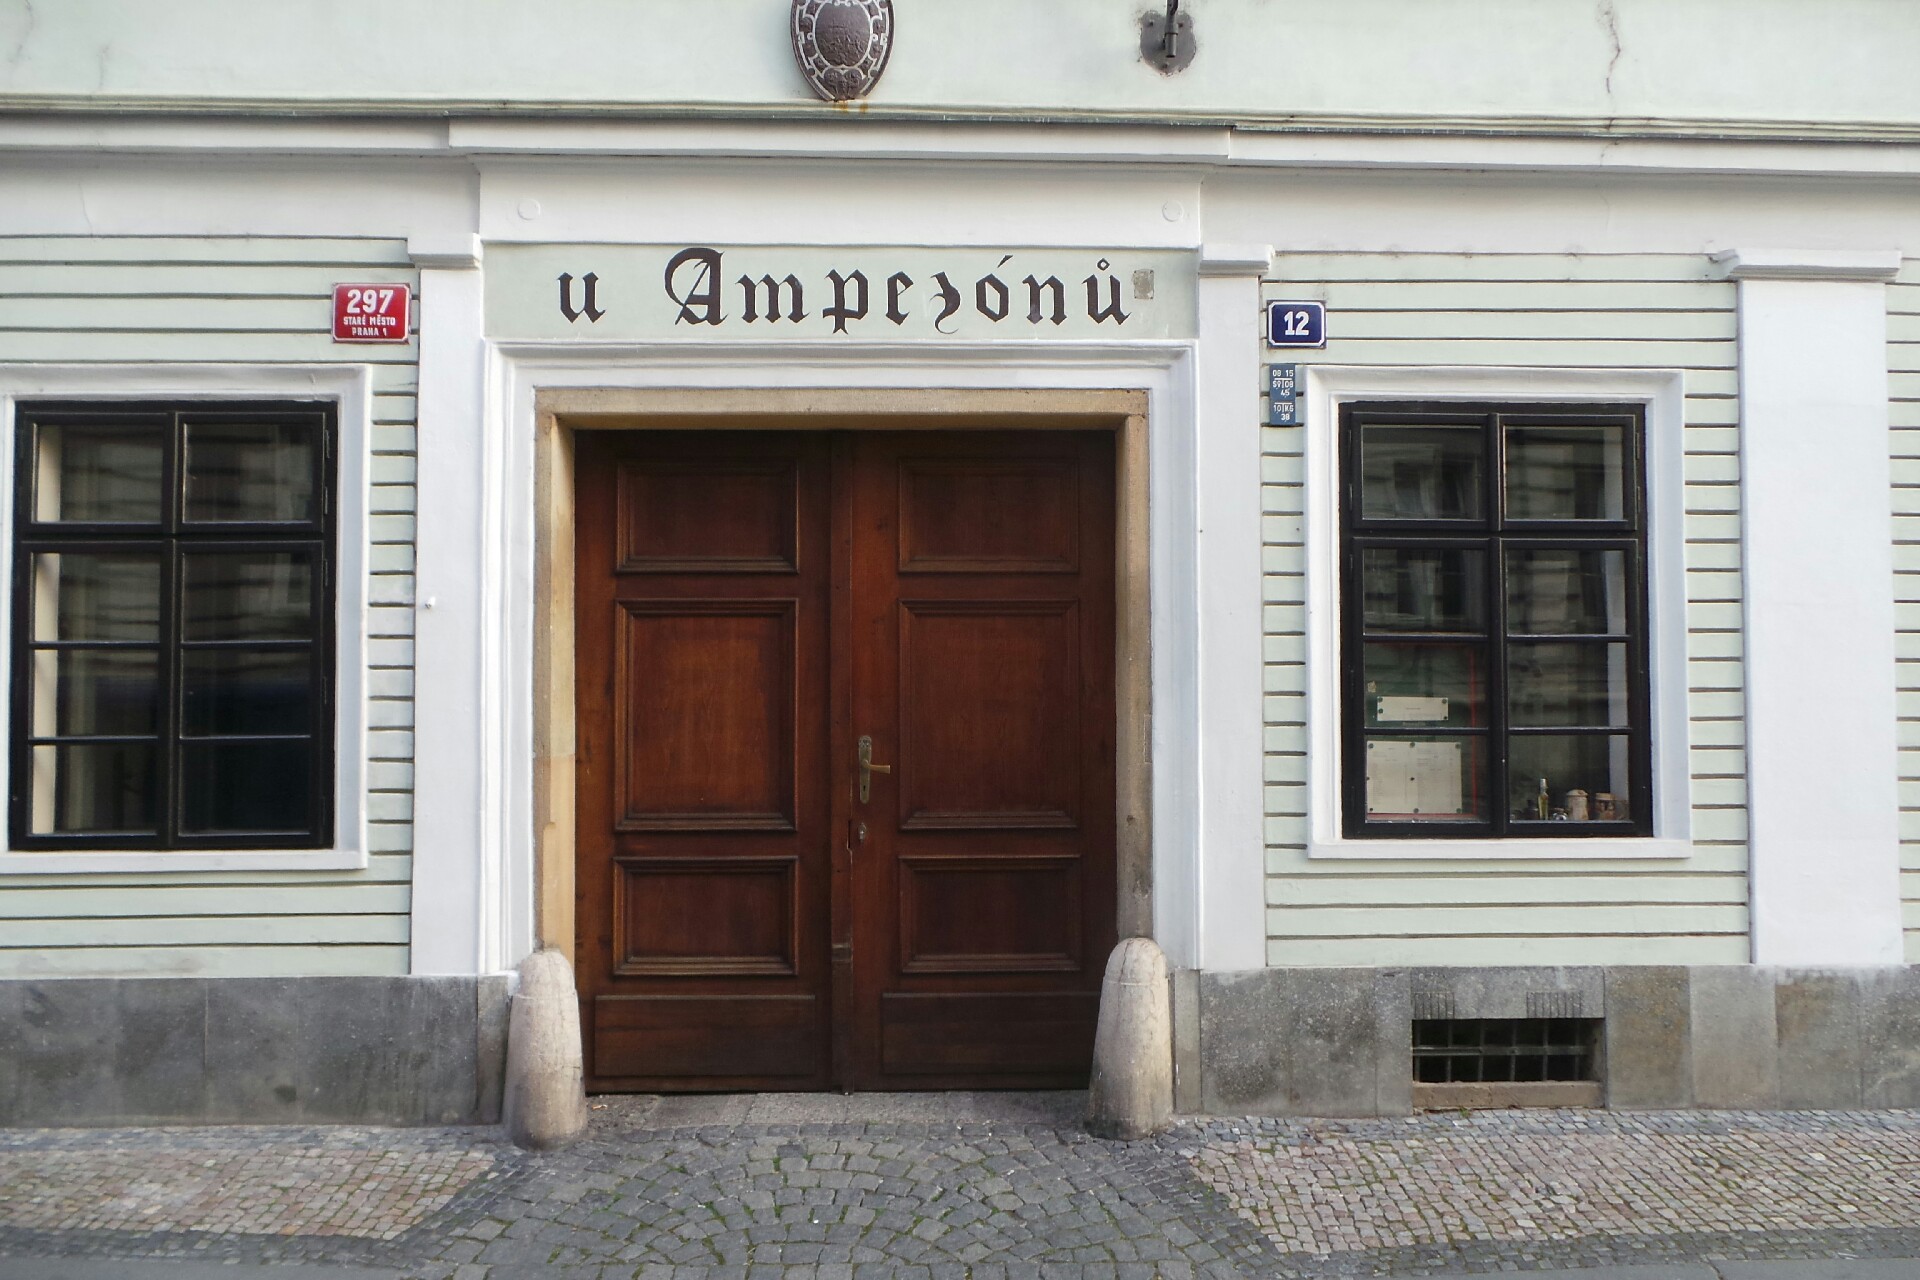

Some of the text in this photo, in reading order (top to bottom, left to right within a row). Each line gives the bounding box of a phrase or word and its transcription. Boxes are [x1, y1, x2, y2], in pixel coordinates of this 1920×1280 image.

[347, 289, 394, 314] 297
[557, 247, 1132, 335] u Ampezónů
[343, 314, 396, 326] STARÉ MĚSTO
[1284, 311, 1310, 336] 12
